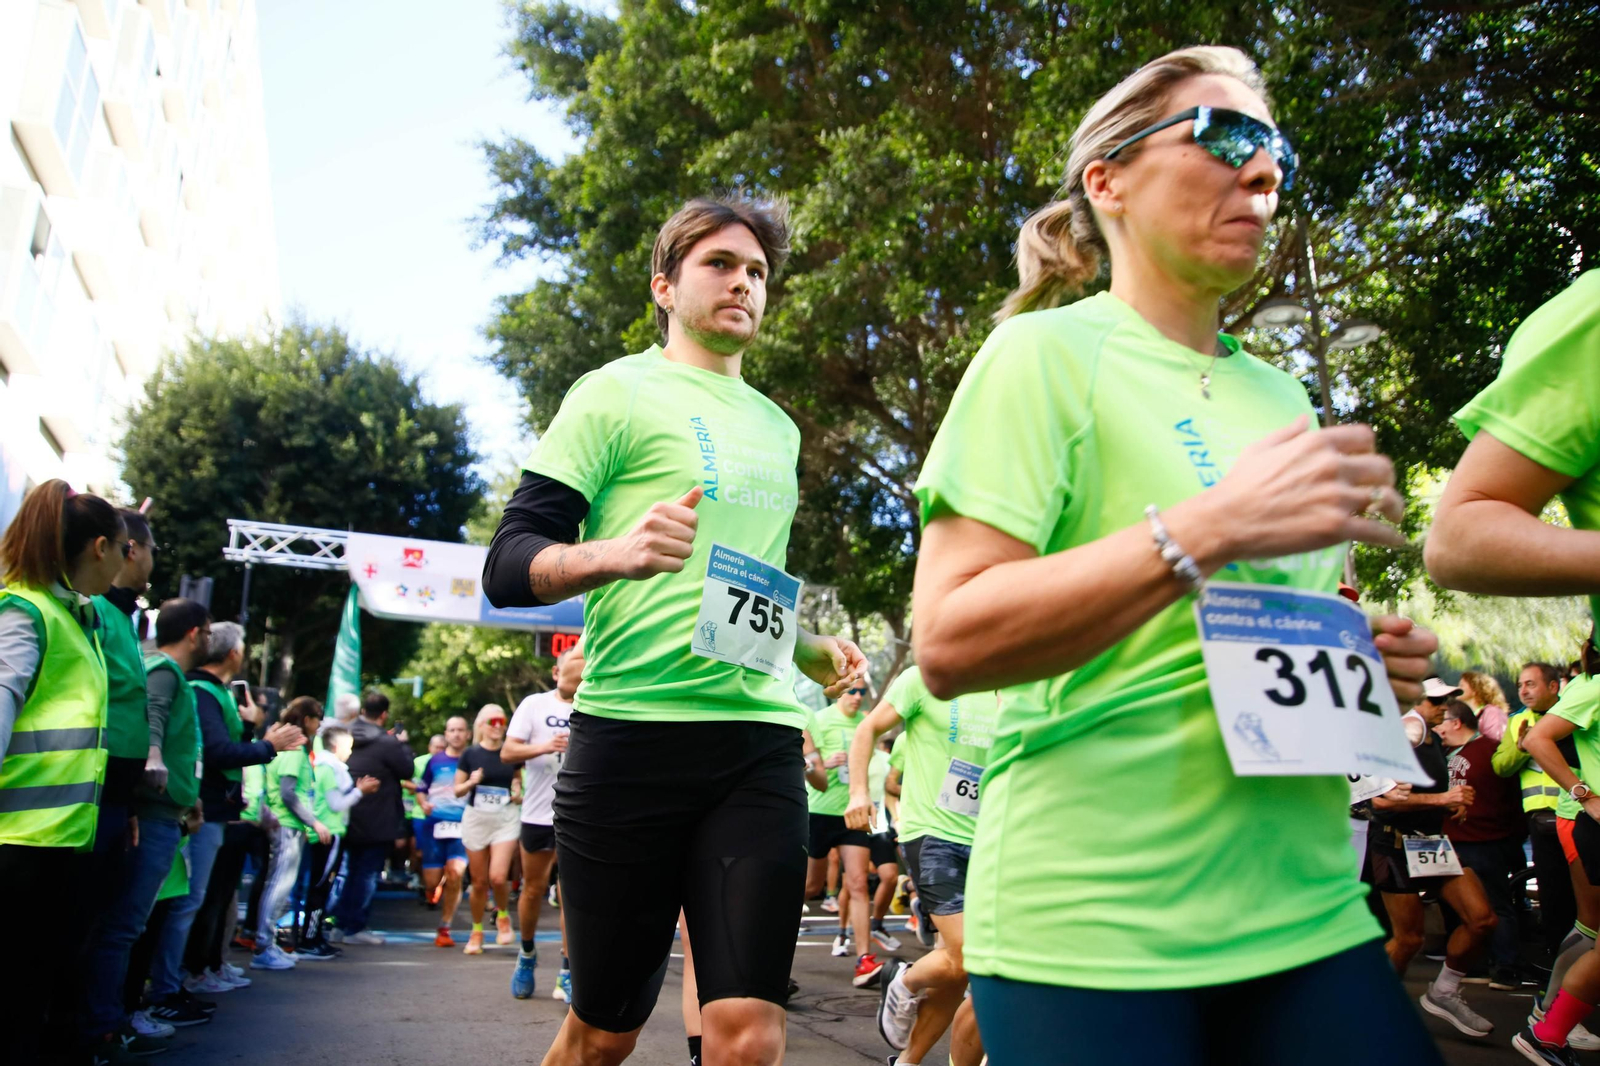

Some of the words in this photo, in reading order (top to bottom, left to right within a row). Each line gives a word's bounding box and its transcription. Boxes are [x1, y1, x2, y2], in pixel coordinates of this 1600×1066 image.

[689, 416, 719, 502] ALMERÍA
[1174, 418, 1222, 487] ERÍA
[722, 459, 783, 483] contra
[723, 481, 798, 513] cánce
[714, 549, 745, 567] Almería
[712, 561, 738, 576] contra
[739, 569, 747, 578] el
[748, 573, 770, 588] cáncer
[728, 586, 784, 640] 755
[1205, 612, 1255, 628] contra
[1257, 615, 1272, 629] el
[1274, 618, 1322, 631] cáncer
[1255, 647, 1383, 717] 312
[1418, 851, 1448, 864] 571
